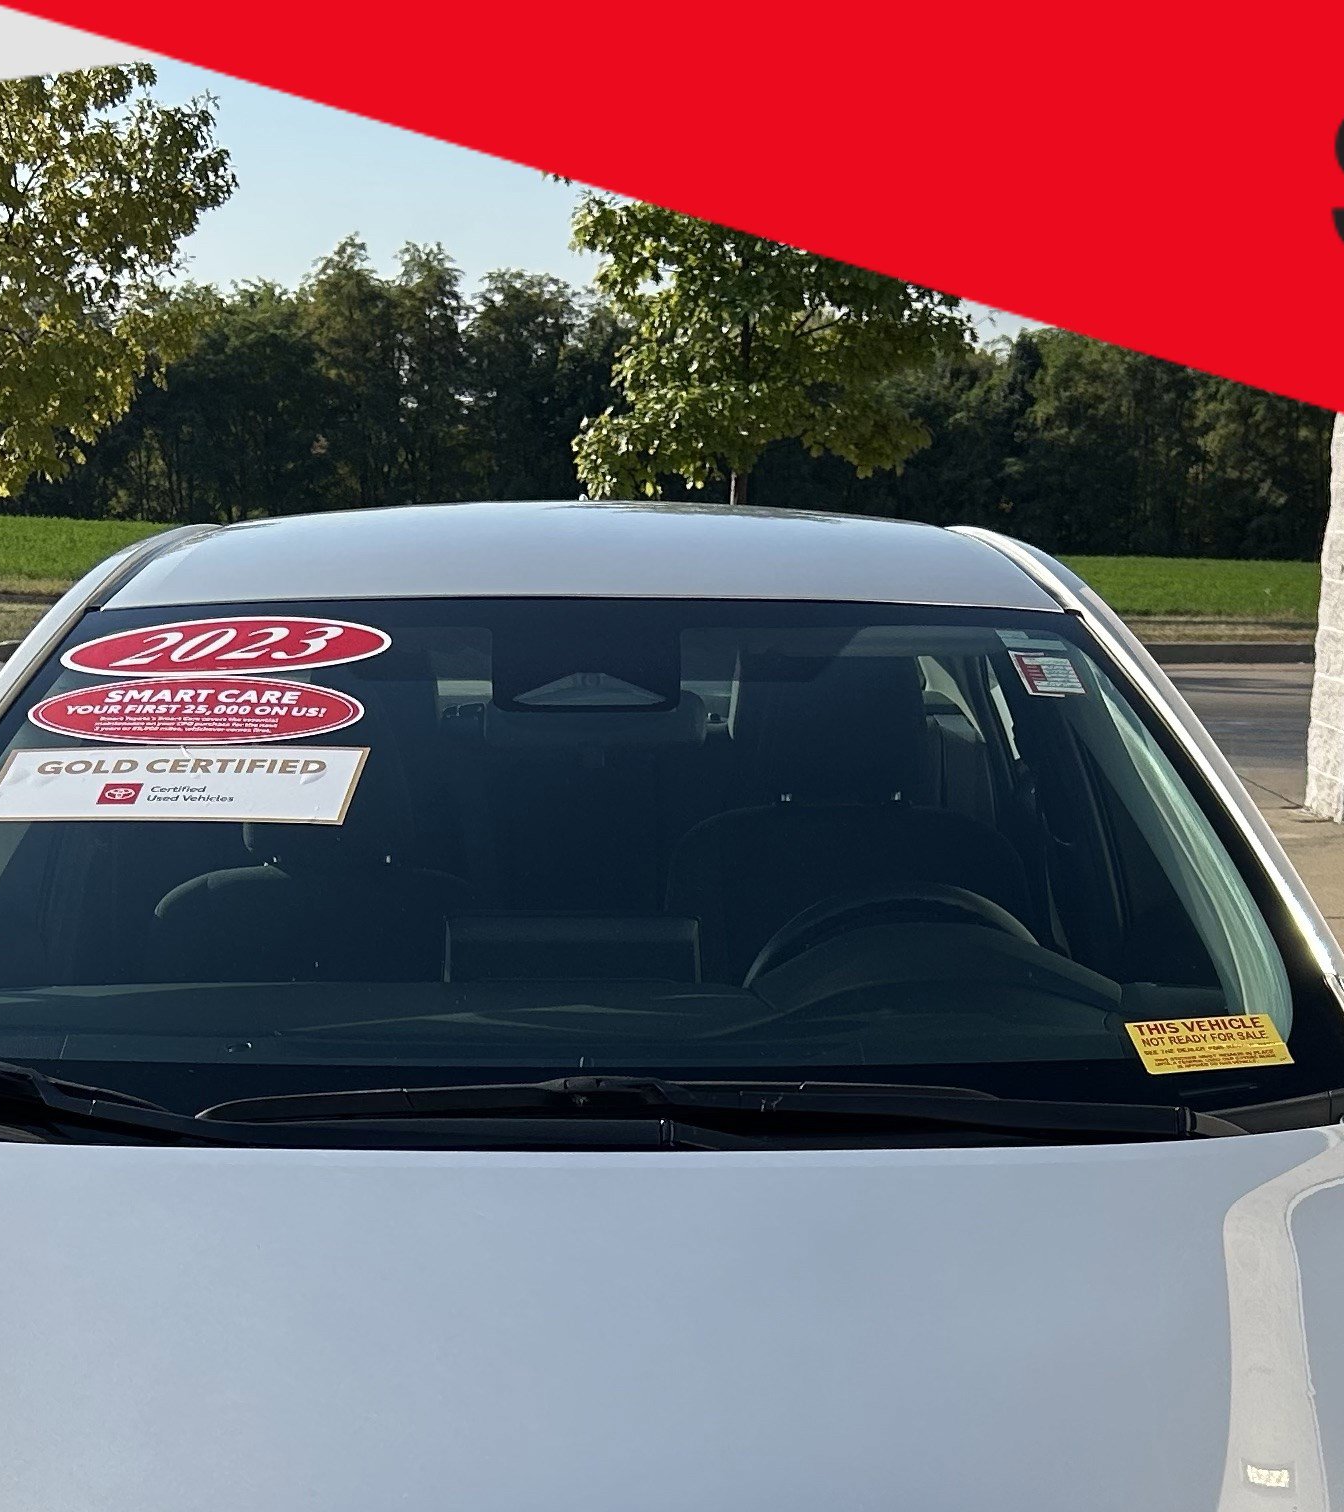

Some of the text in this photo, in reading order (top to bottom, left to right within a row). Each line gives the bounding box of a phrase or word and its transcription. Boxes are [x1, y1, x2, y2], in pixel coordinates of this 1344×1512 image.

[109, 625, 345, 668] 2023
[104, 689, 302, 704] SMART CARE
[66, 704, 327, 718] YOUR FIRST 25,000 ON US!
[37, 758, 326, 776] GOLD CERTIFIED
[1133, 1017, 1265, 1036] THIS VEHICLE
[1141, 1030, 1269, 1047] NOT READY FOR SALE
